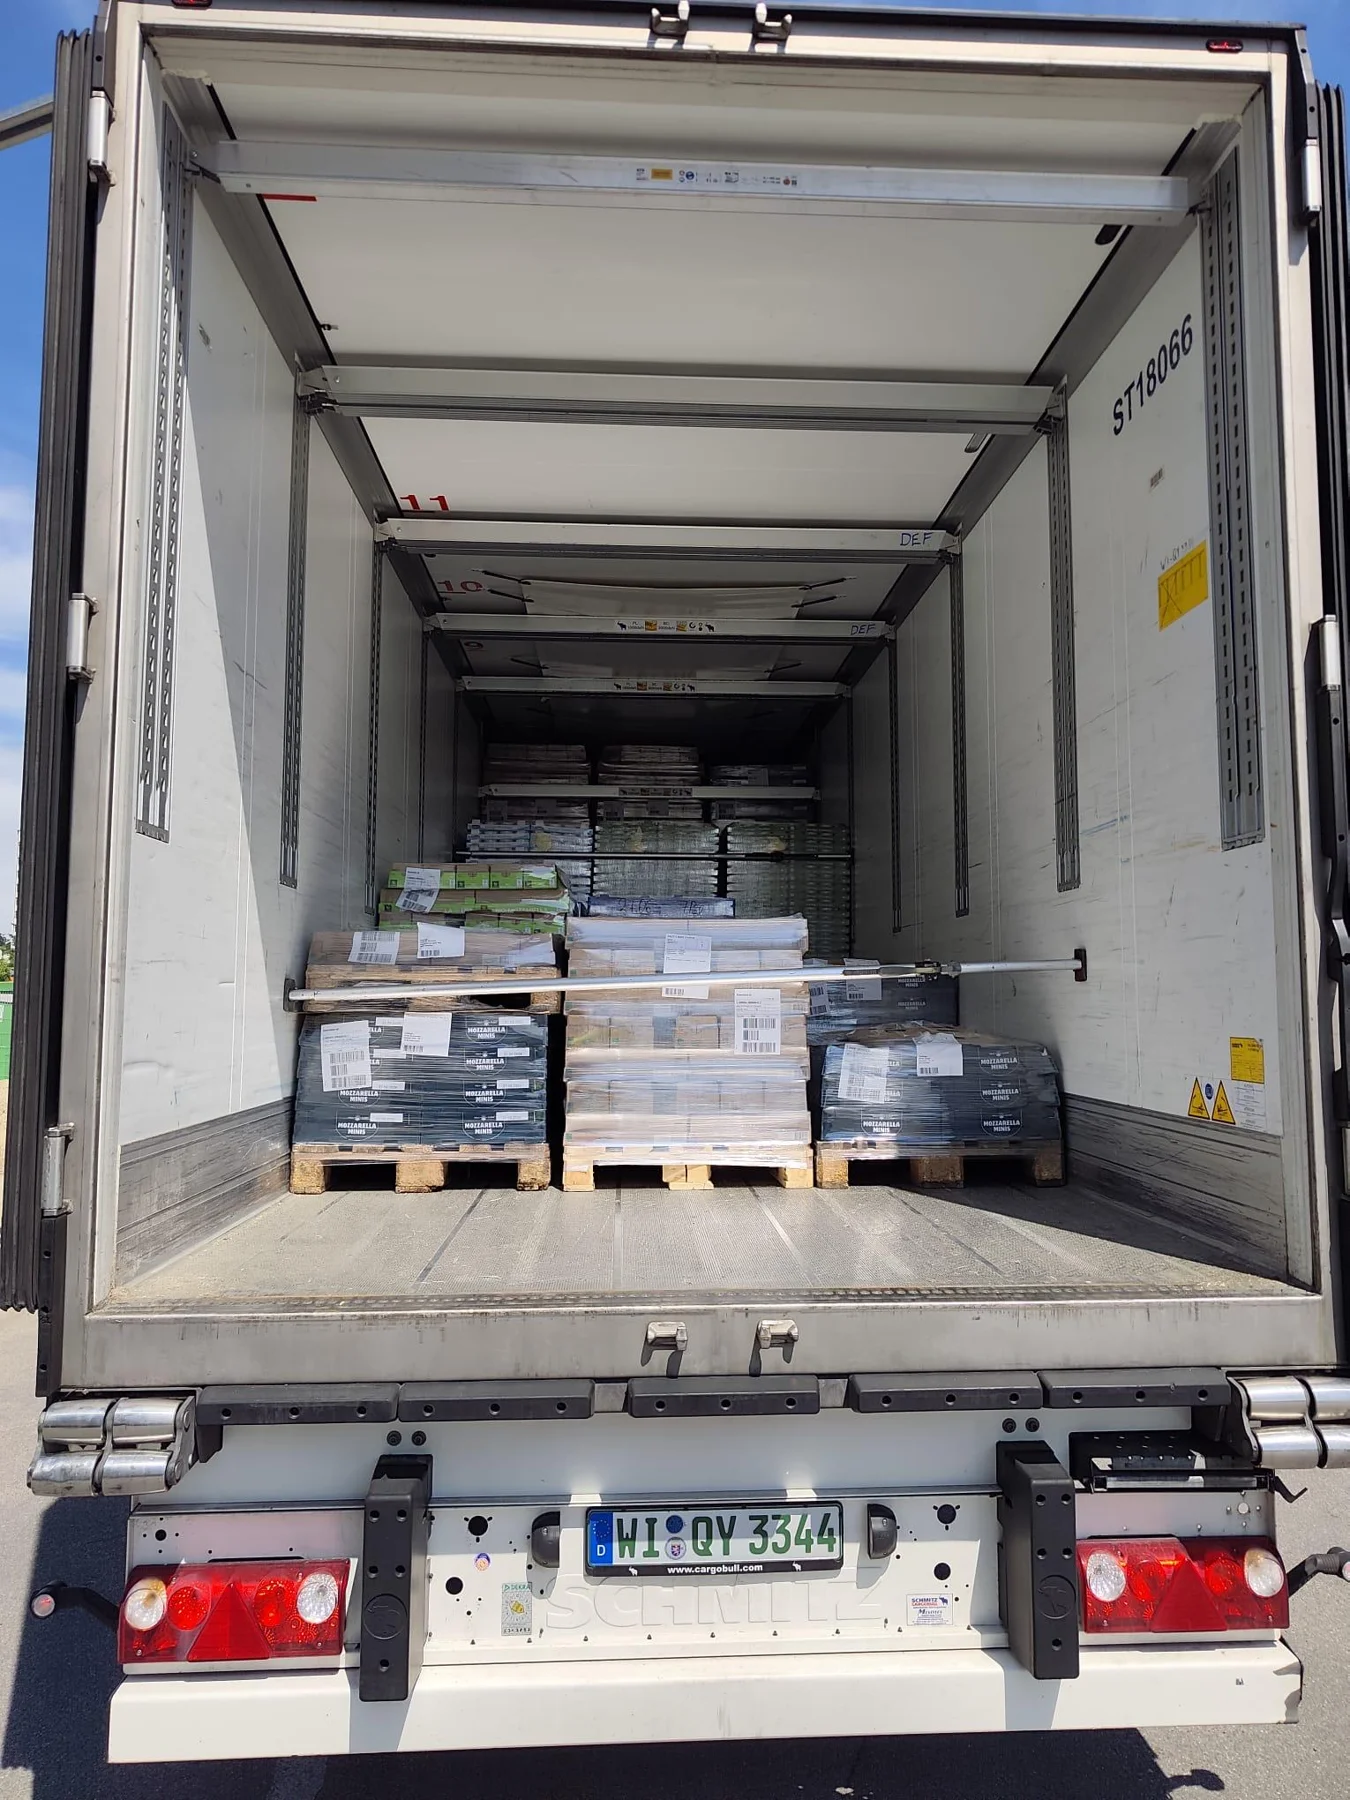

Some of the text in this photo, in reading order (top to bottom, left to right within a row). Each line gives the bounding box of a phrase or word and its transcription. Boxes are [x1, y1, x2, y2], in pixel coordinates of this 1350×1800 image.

[1112, 313, 1193, 436] ST18066
[400, 494, 450, 511] 11
[900, 532, 933, 546] DEF
[437, 580, 483, 592] 10
[850, 623, 876, 636] DEF
[982, 1088, 1019, 1096] MOZZARELLA
[616, 1512, 837, 1558] WI QY 3344
[596, 1544, 606, 1556] D
[667, 1563, 763, 1574] www.cargobull.com
[546, 1575, 883, 1629] SCHMITZ
